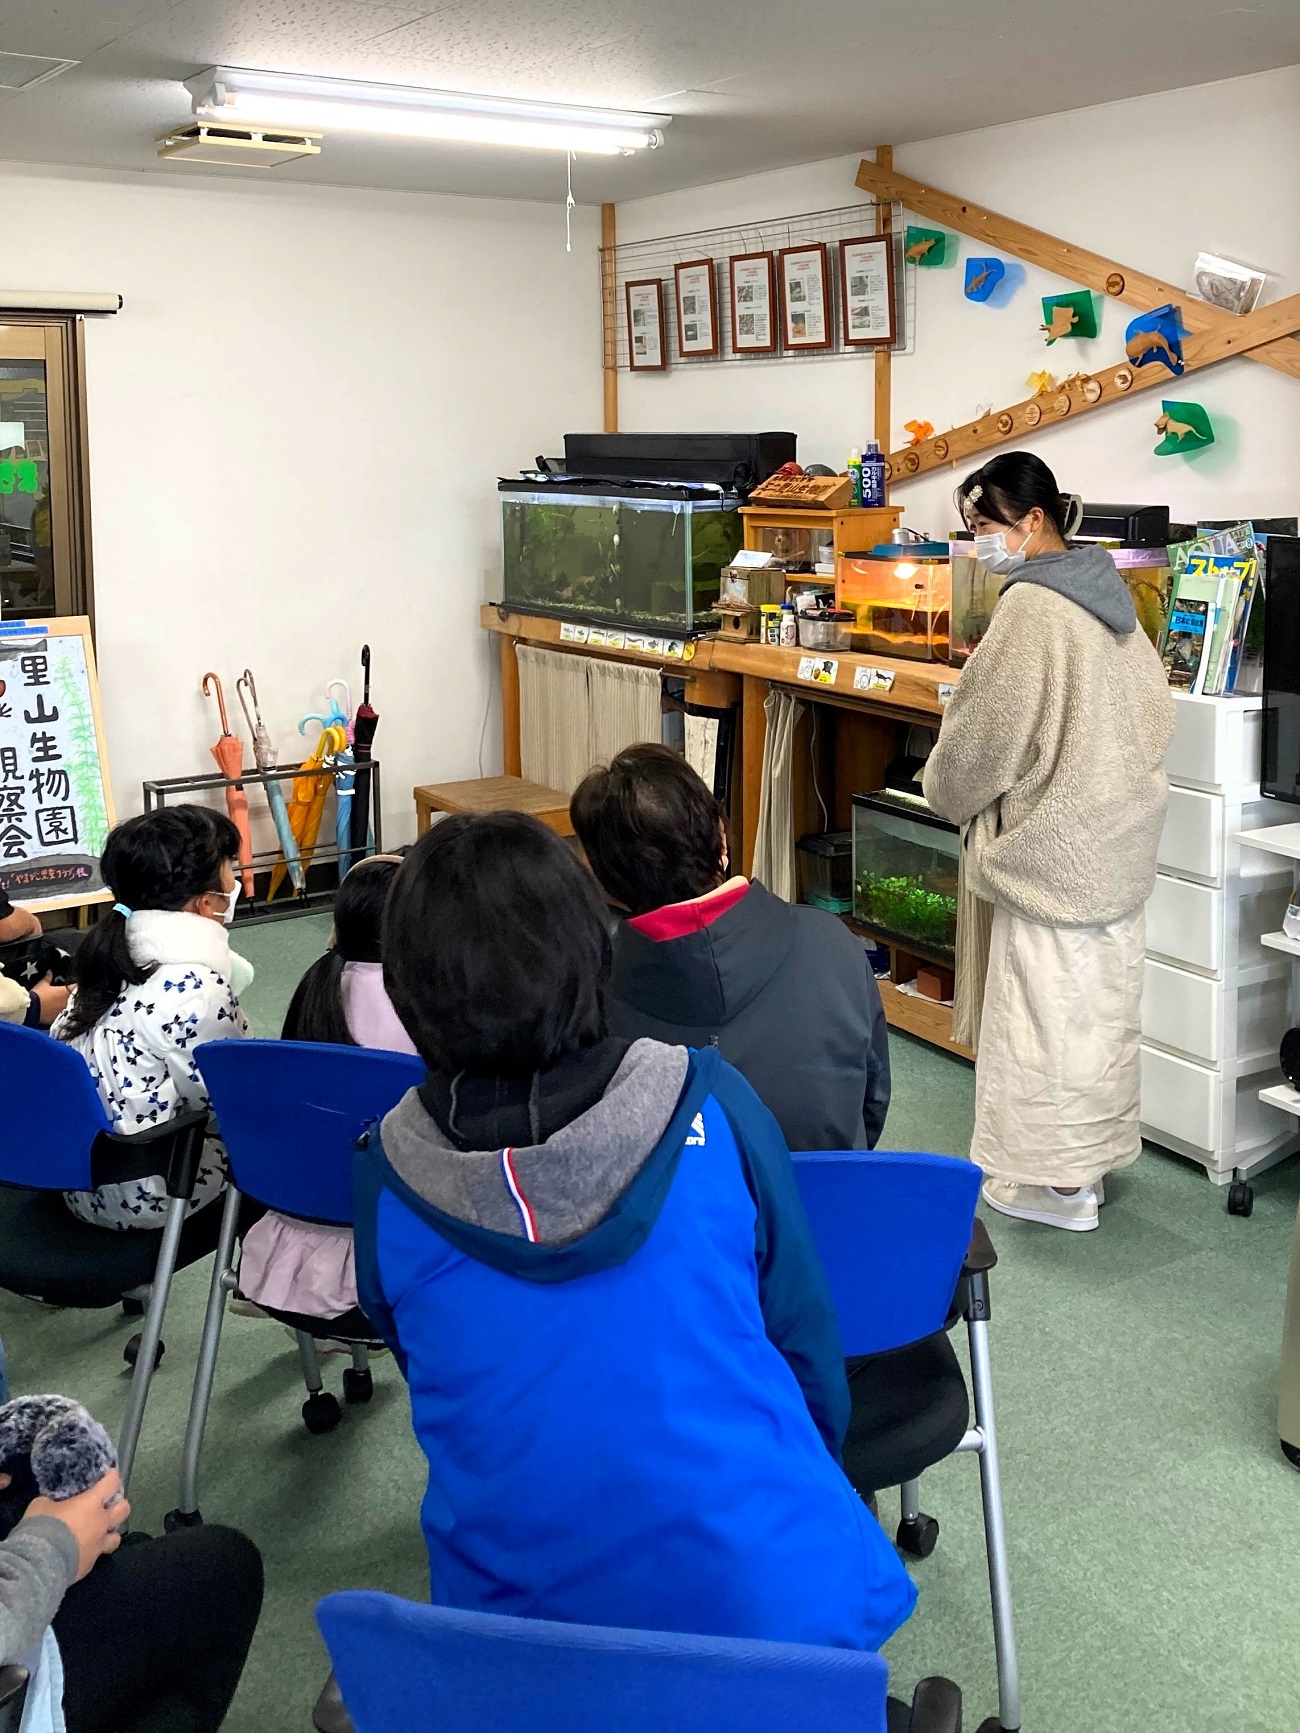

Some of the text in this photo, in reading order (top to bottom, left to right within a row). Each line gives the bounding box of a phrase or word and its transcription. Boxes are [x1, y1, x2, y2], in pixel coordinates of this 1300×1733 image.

[862, 467, 872, 499] 500
[20, 655, 79, 847] 里山生物園
